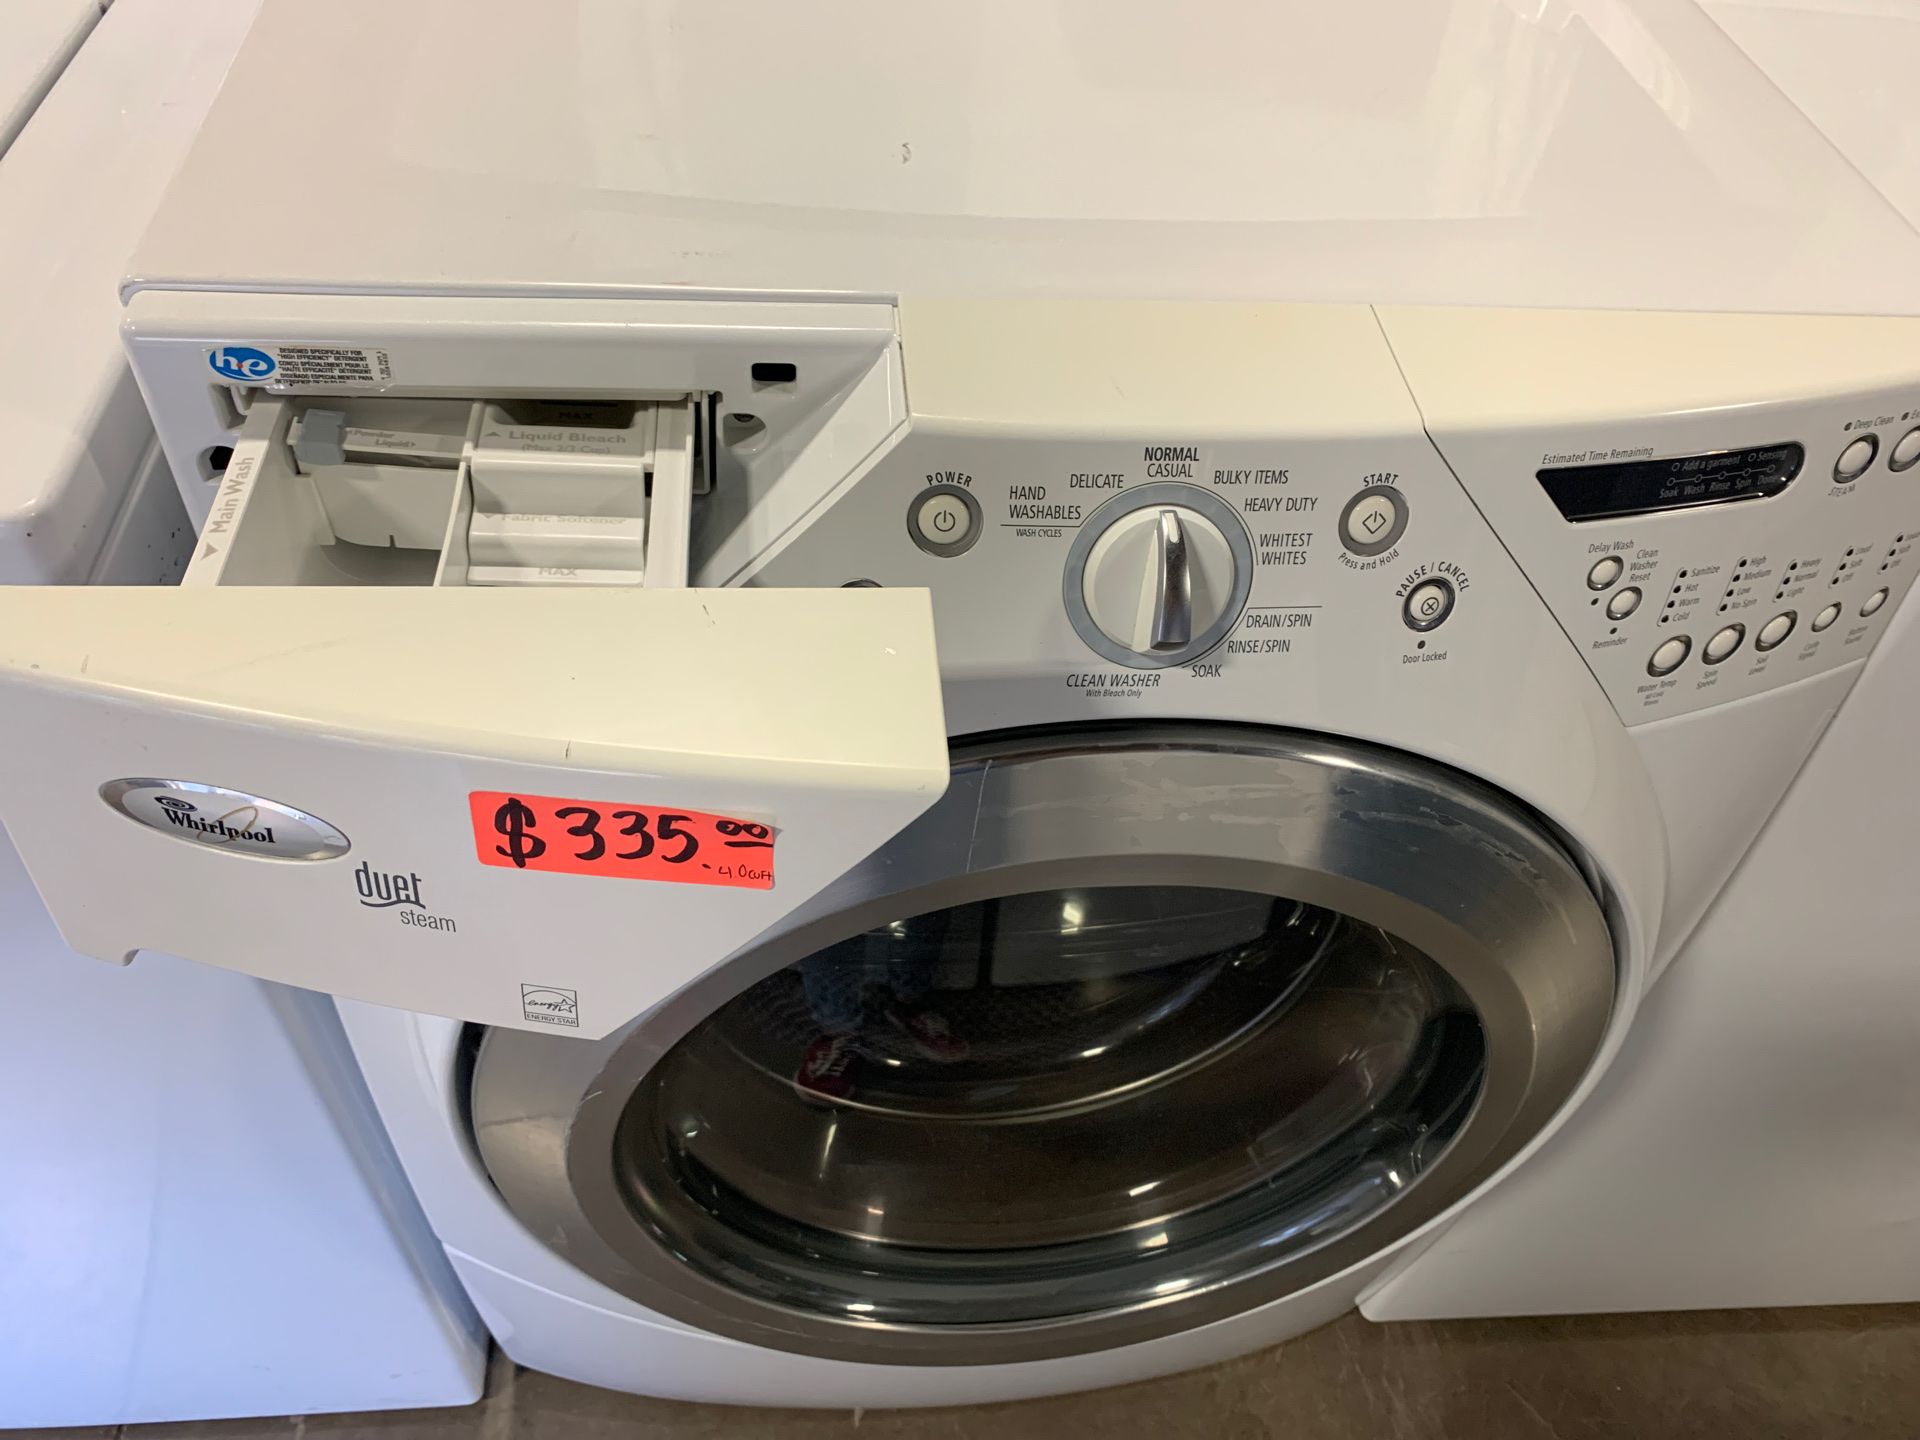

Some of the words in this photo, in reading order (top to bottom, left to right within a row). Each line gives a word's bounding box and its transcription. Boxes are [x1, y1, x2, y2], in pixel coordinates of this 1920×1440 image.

[508, 430, 563, 442] Liquid
[569, 432, 627, 443] Bleach
[1144, 447, 1200, 462] NORMAL
[1542, 451, 1586, 465] Estimated
[1588, 450, 1609, 462] Time
[1610, 446, 1655, 460] Remaining
[1758, 450, 1788, 462] Sensing
[1147, 463, 1193, 478] CASUAL
[1682, 459, 1698, 471] Add
[1706, 455, 1741, 471] garment
[926, 471, 972, 487] POWER
[1070, 474, 1124, 489] DELICATE
[1213, 470, 1252, 485] BULKY
[1254, 470, 1289, 485] ITEMS
[1363, 473, 1398, 487] START
[208, 499, 238, 534] Main
[223, 457, 255, 496] Wash
[1009, 485, 1046, 501] HAND
[1660, 487, 1678, 499] Soak
[1684, 485, 1706, 496] Wash
[1709, 481, 1731, 492] Rinse
[1735, 478, 1752, 490] Spin
[1009, 504, 1081, 520] WASHABLES
[1244, 498, 1286, 512] HEAVY
[1286, 497, 1318, 512] DUTY
[1016, 529, 1036, 538] WASH
[1038, 529, 1062, 538] CYCLES
[1259, 533, 1313, 548] WHITEST
[1588, 542, 1611, 554] Delay
[1613, 539, 1634, 551] Wash
[1636, 548, 1659, 560] Clean
[1261, 551, 1307, 566] WHITES
[1338, 552, 1358, 569] Press
[1360, 561, 1377, 571] and
[1379, 548, 1399, 566] Hold
[1629, 560, 1659, 571] Washer
[538, 567, 579, 577] MAX
[1396, 564, 1428, 597] PAUSE
[1438, 561, 1470, 592] CANCEL
[1629, 572, 1652, 583] Reset
[1691, 565, 1720, 578] Sanitize
[1684, 583, 1699, 593] Hot
[1246, 614, 1312, 629] DRAIN/SPIN
[1672, 611, 1691, 622] Cold
[1227, 639, 1291, 654] RINSE/SPIN
[1591, 637, 1628, 650] Reminder
[1402, 653, 1421, 664] Door
[1422, 651, 1448, 663] Locked
[1191, 664, 1223, 678] SOAK
[1066, 674, 1107, 688] CLEAN
[1110, 673, 1161, 688] WASHER
[1086, 689, 1102, 698] With
[1103, 689, 1126, 698] Bleach
[1127, 689, 1143, 699] Only
[160, 806, 276, 844] Whirlpool
[354, 860, 426, 909] duet
[400, 909, 457, 933] steam
[556, 1017, 577, 1026] STAR
